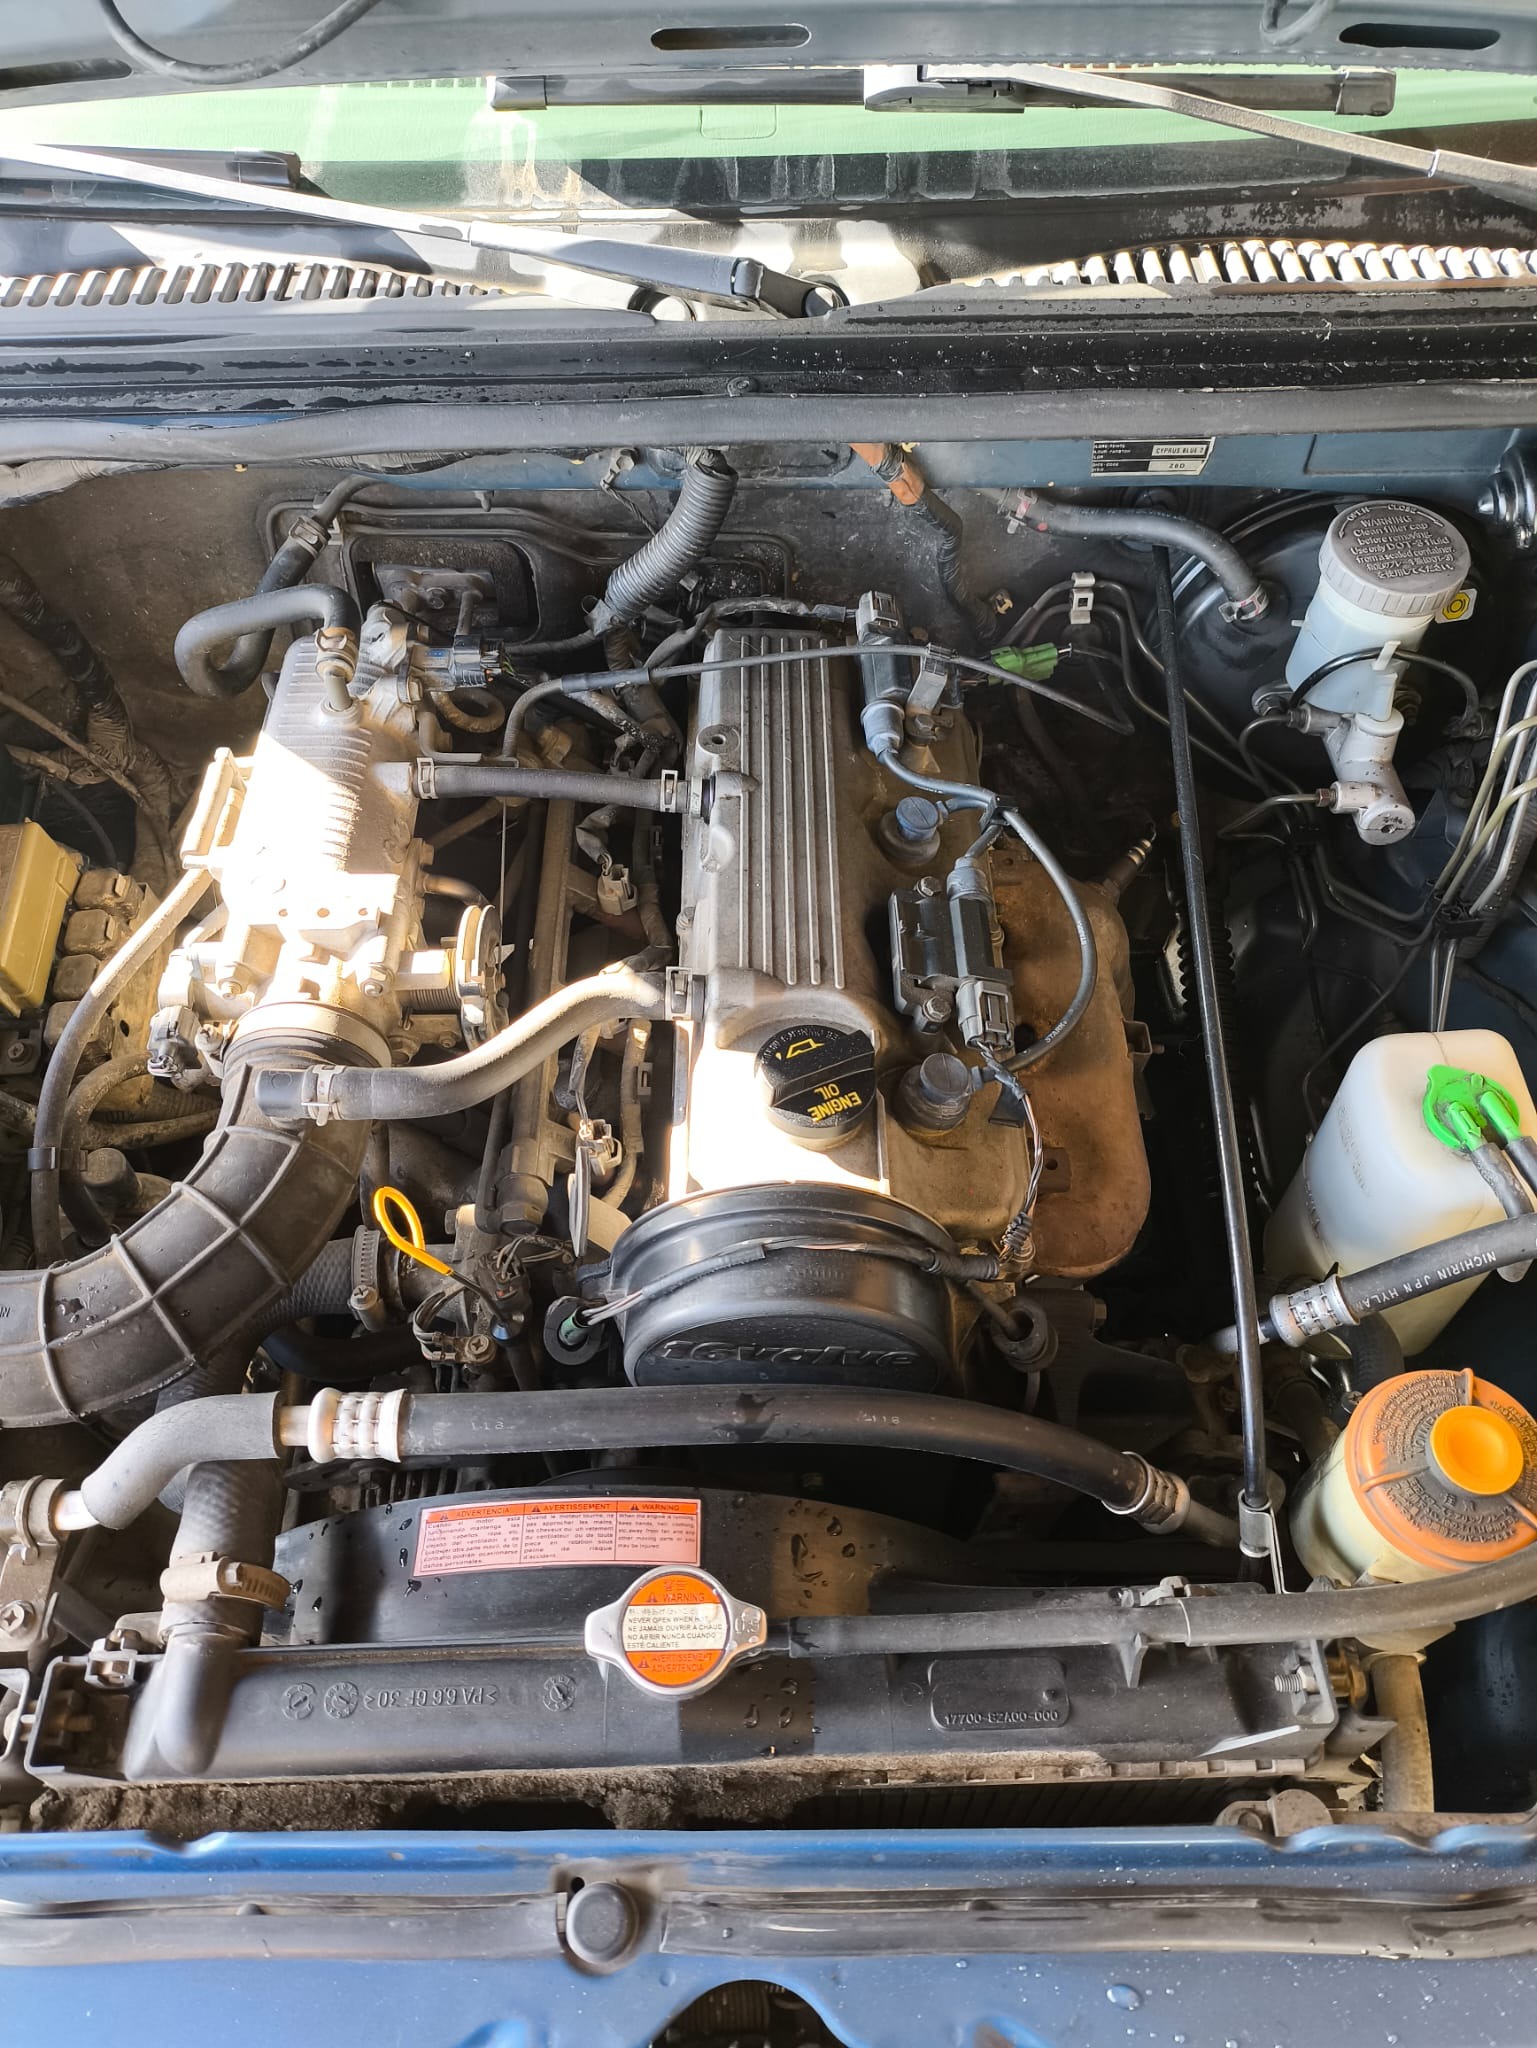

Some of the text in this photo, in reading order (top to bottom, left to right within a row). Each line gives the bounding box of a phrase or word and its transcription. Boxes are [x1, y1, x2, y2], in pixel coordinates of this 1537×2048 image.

[1347, 506, 1370, 521] OPEN
[1360, 515, 1412, 528] WARNING
[1353, 526, 1382, 537] Clean
[1409, 523, 1428, 531] cap
[1357, 535, 1385, 546] before
[1350, 545, 1367, 555] Use
[1368, 545, 1386, 553] only
[1356, 555, 1379, 564] from
[1385, 552, 1412, 560] sealed
[814, 1083, 840, 1100] OIL
[808, 1092, 862, 1123] ENGINE
[1437, 1250, 1497, 1280] NICHIRIN
[1403, 1275, 1431, 1293] JPN
[456, 1508, 510, 1518] ADVERTENCIA
[664, 1593, 705, 1602] WARNING
[652, 1653, 712, 1661] AVERTISSEMENT
[652, 1664, 703, 1672] ADVERTENCIA
